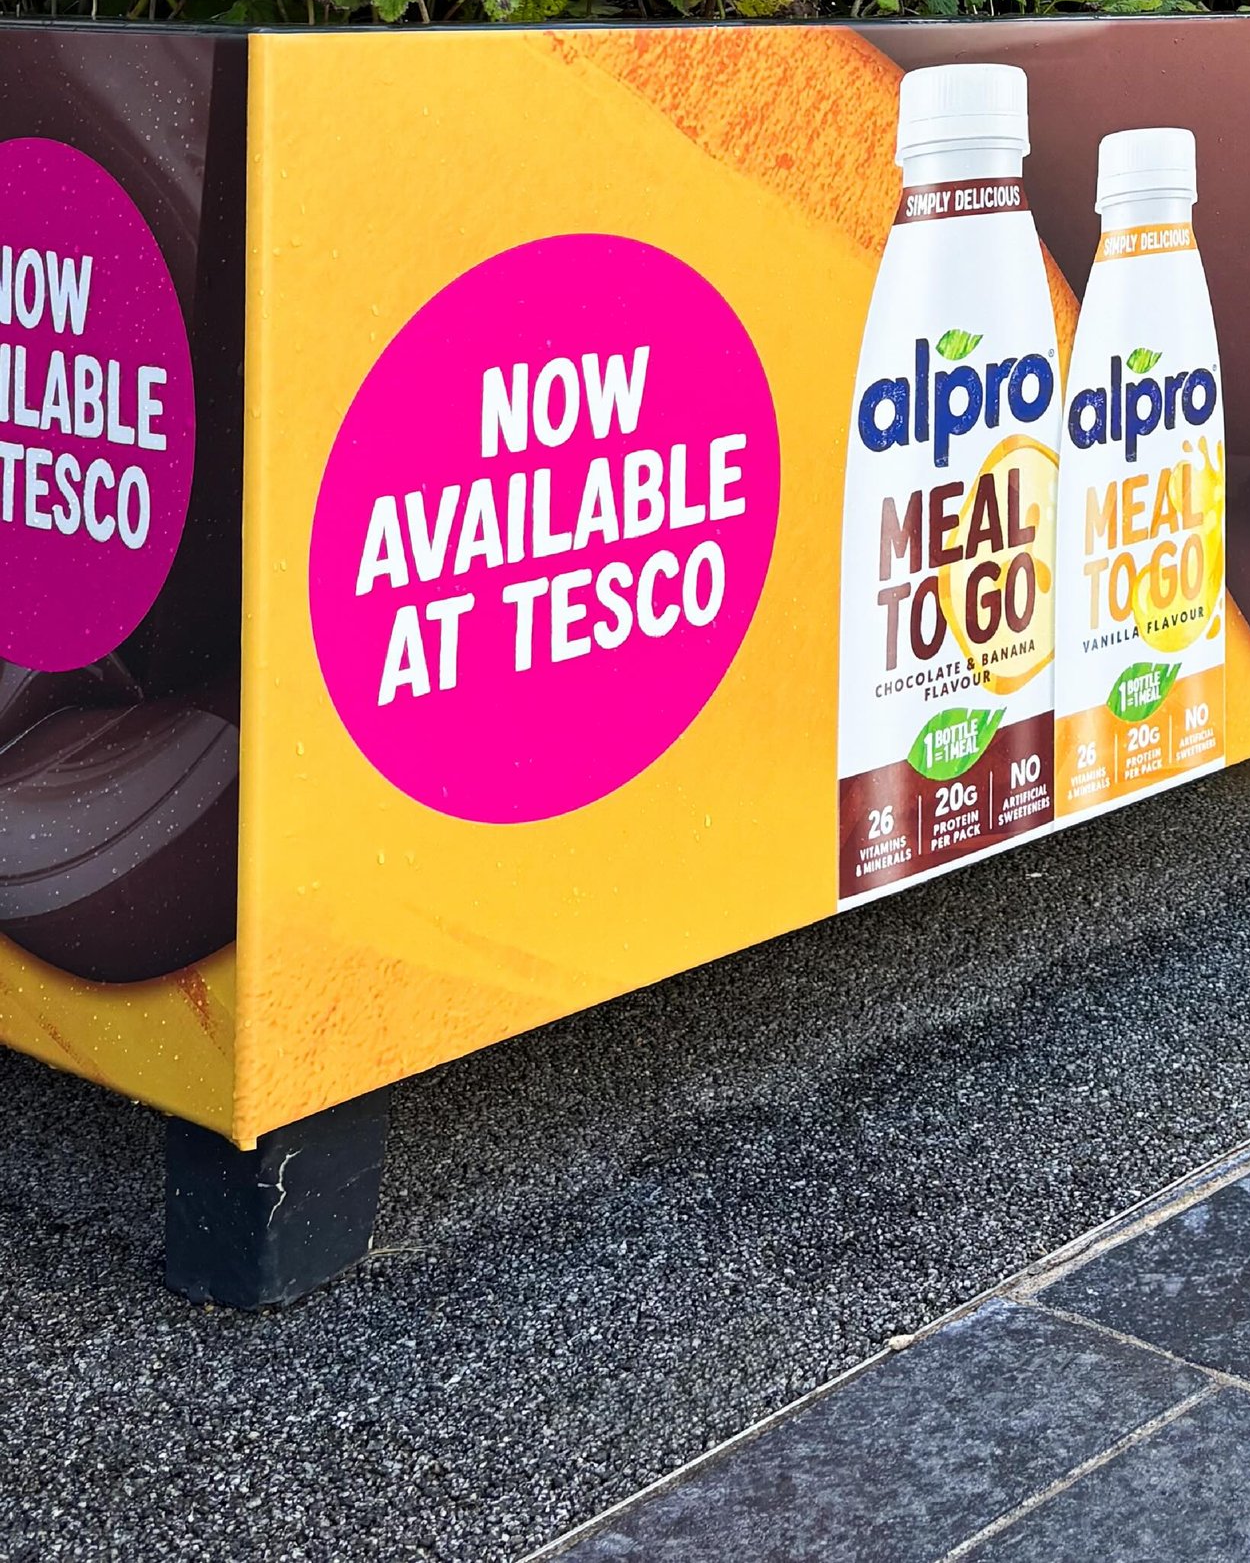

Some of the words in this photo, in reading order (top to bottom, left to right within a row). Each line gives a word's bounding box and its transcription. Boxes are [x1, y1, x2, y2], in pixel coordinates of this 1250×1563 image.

[906, 191, 951, 217] SIMPLY
[955, 186, 1020, 211] DELICIOUS
[1103, 233, 1138, 256] SIMPLY
[1141, 229, 1190, 250] DELICIOUS
[481, 345, 650, 458] NOW
[858, 338, 1054, 468] alpro
[1068, 355, 1217, 463] alpro
[355, 433, 747, 596] AVAILABLE
[879, 468, 1036, 581] MEAL
[1084, 463, 1204, 556] MEAL
[1083, 551, 1137, 630] TO
[1148, 534, 1204, 610] GO
[377, 592, 475, 706] AT
[502, 540, 725, 672] TESCO
[877, 575, 947, 672] TO
[965, 552, 1036, 645] GO
[1083, 626, 1140, 653] VANILLA
[1146, 606, 1205, 634] FLAVOUR
[875, 662, 962, 698] CHOCOLATE
[967, 657, 976, 673] &
[982, 639, 1036, 667] BANANA
[924, 670, 991, 702] FLAVOUR
[1118, 682, 1126, 713] 1
[1127, 671, 1161, 693] BOTTLE
[1185, 702, 1209, 731] NO
[924, 732, 933, 769] 1
[935, 718, 978, 748] BOTTLE
[1077, 741, 1097, 769] 26
[1127, 723, 1160, 752] 20G
[1010, 754, 1041, 789] NO
[1124, 766, 1140, 780] PER
[1141, 760, 1162, 776] PACK
[1126, 747, 1161, 768] PROTEIN
[1070, 766, 1106, 787] VITAMINS
[934, 782, 978, 818] 20G
[998, 796, 1050, 826] SWEETENERS
[1002, 784, 1048, 811] ARTIFICIAL
[868, 805, 894, 840] 26
[930, 833, 950, 851] PER
[953, 824, 981, 845] PACK
[933, 810, 979, 836] PROTEIN
[859, 835, 907, 862] VITAMINS
[863, 848, 912, 874] MINERALS
